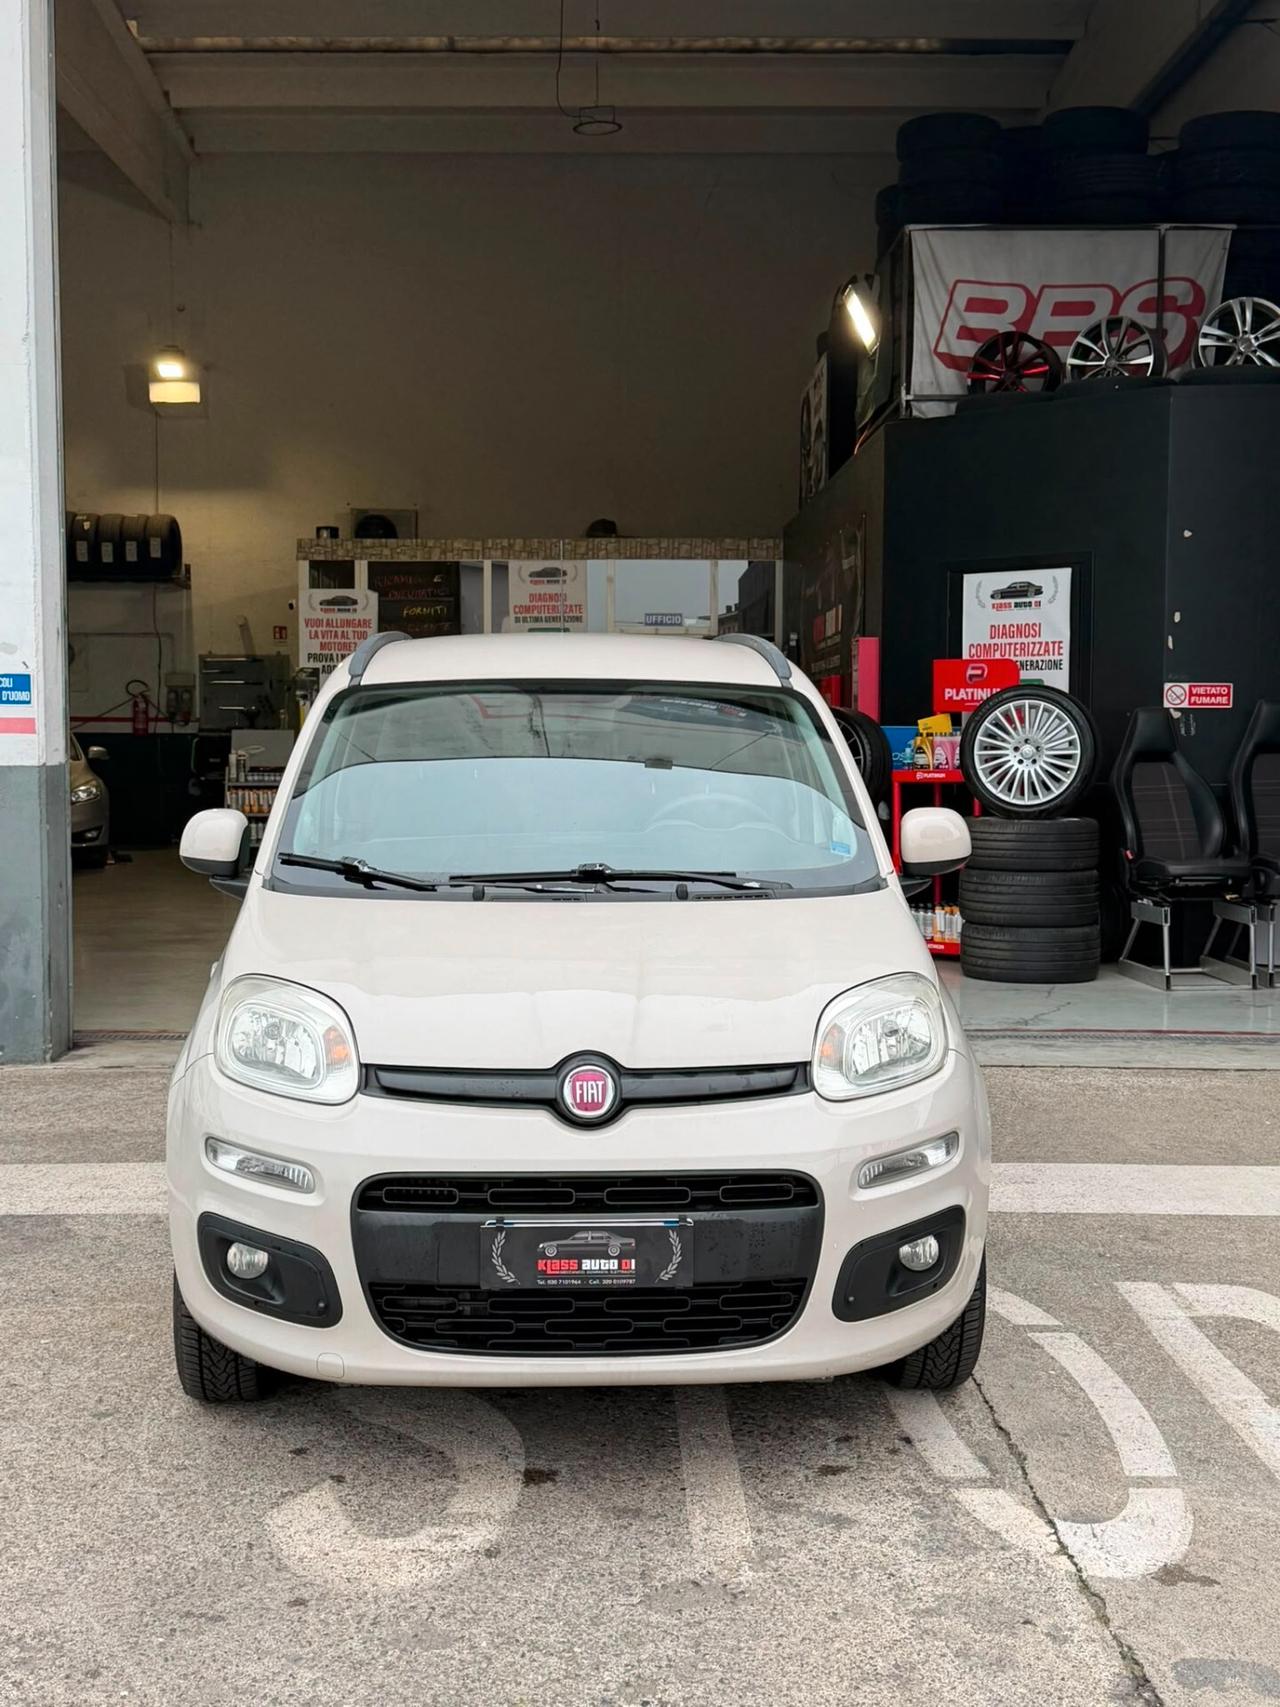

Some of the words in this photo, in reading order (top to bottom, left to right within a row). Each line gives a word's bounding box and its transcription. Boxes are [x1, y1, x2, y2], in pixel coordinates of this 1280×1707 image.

[402, 605, 447, 617] FORNITI
[304, 618, 324, 628] VUOI
[325, 618, 372, 628] ALLUNGARE
[646, 615, 681, 625] UFFICIO
[309, 630, 319, 640] LA
[320, 630, 339, 640] VITA
[340, 630, 350, 640] AL
[352, 630, 368, 640] TUO
[989, 623, 1041, 640] DIAGNOSI
[968, 641, 1064, 659] COMPUTERIZZATE
[307, 653, 334, 663] PROVA
[2, 690, 30, 701] D'UOMO
[1190, 696, 1229, 704] FUMARE
[575, 1081, 605, 1104] FIAT
